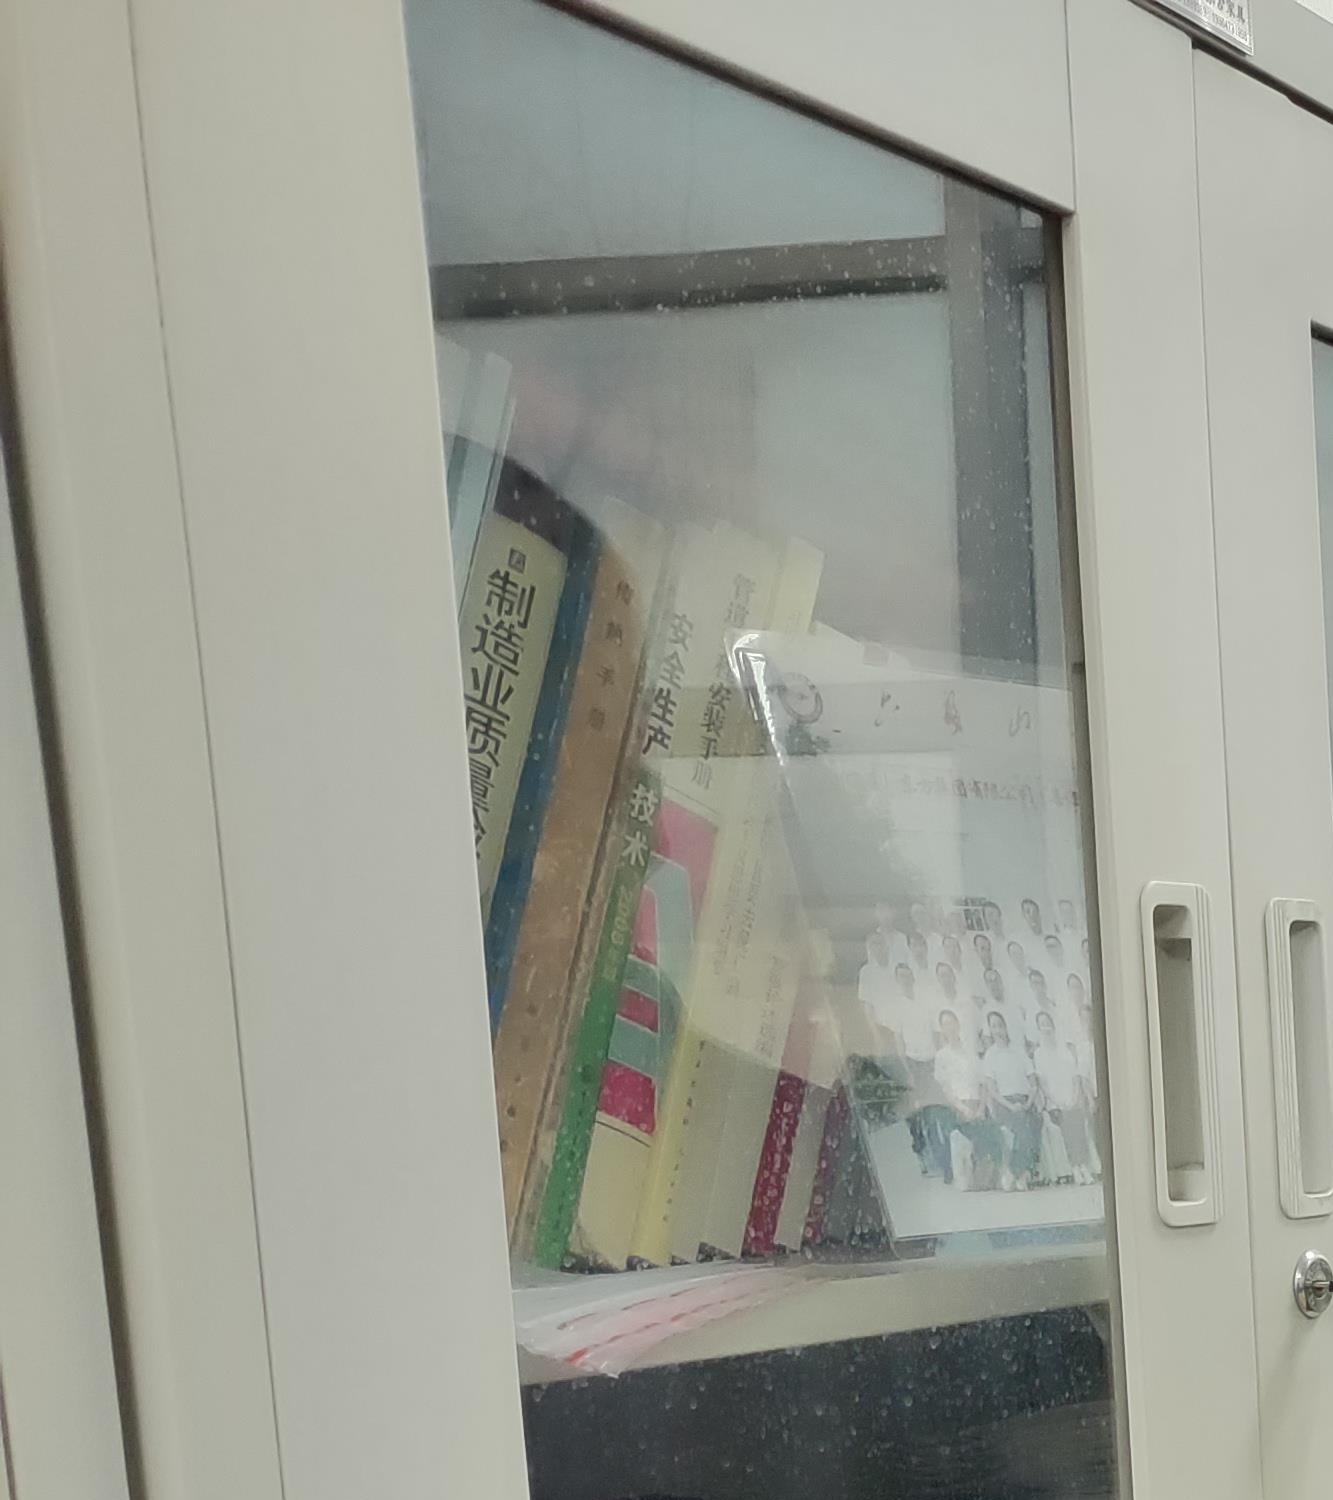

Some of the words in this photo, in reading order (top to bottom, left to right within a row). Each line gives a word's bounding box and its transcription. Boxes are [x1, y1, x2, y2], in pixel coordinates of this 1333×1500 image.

[621, 612, 694, 867] 安全生产技术
